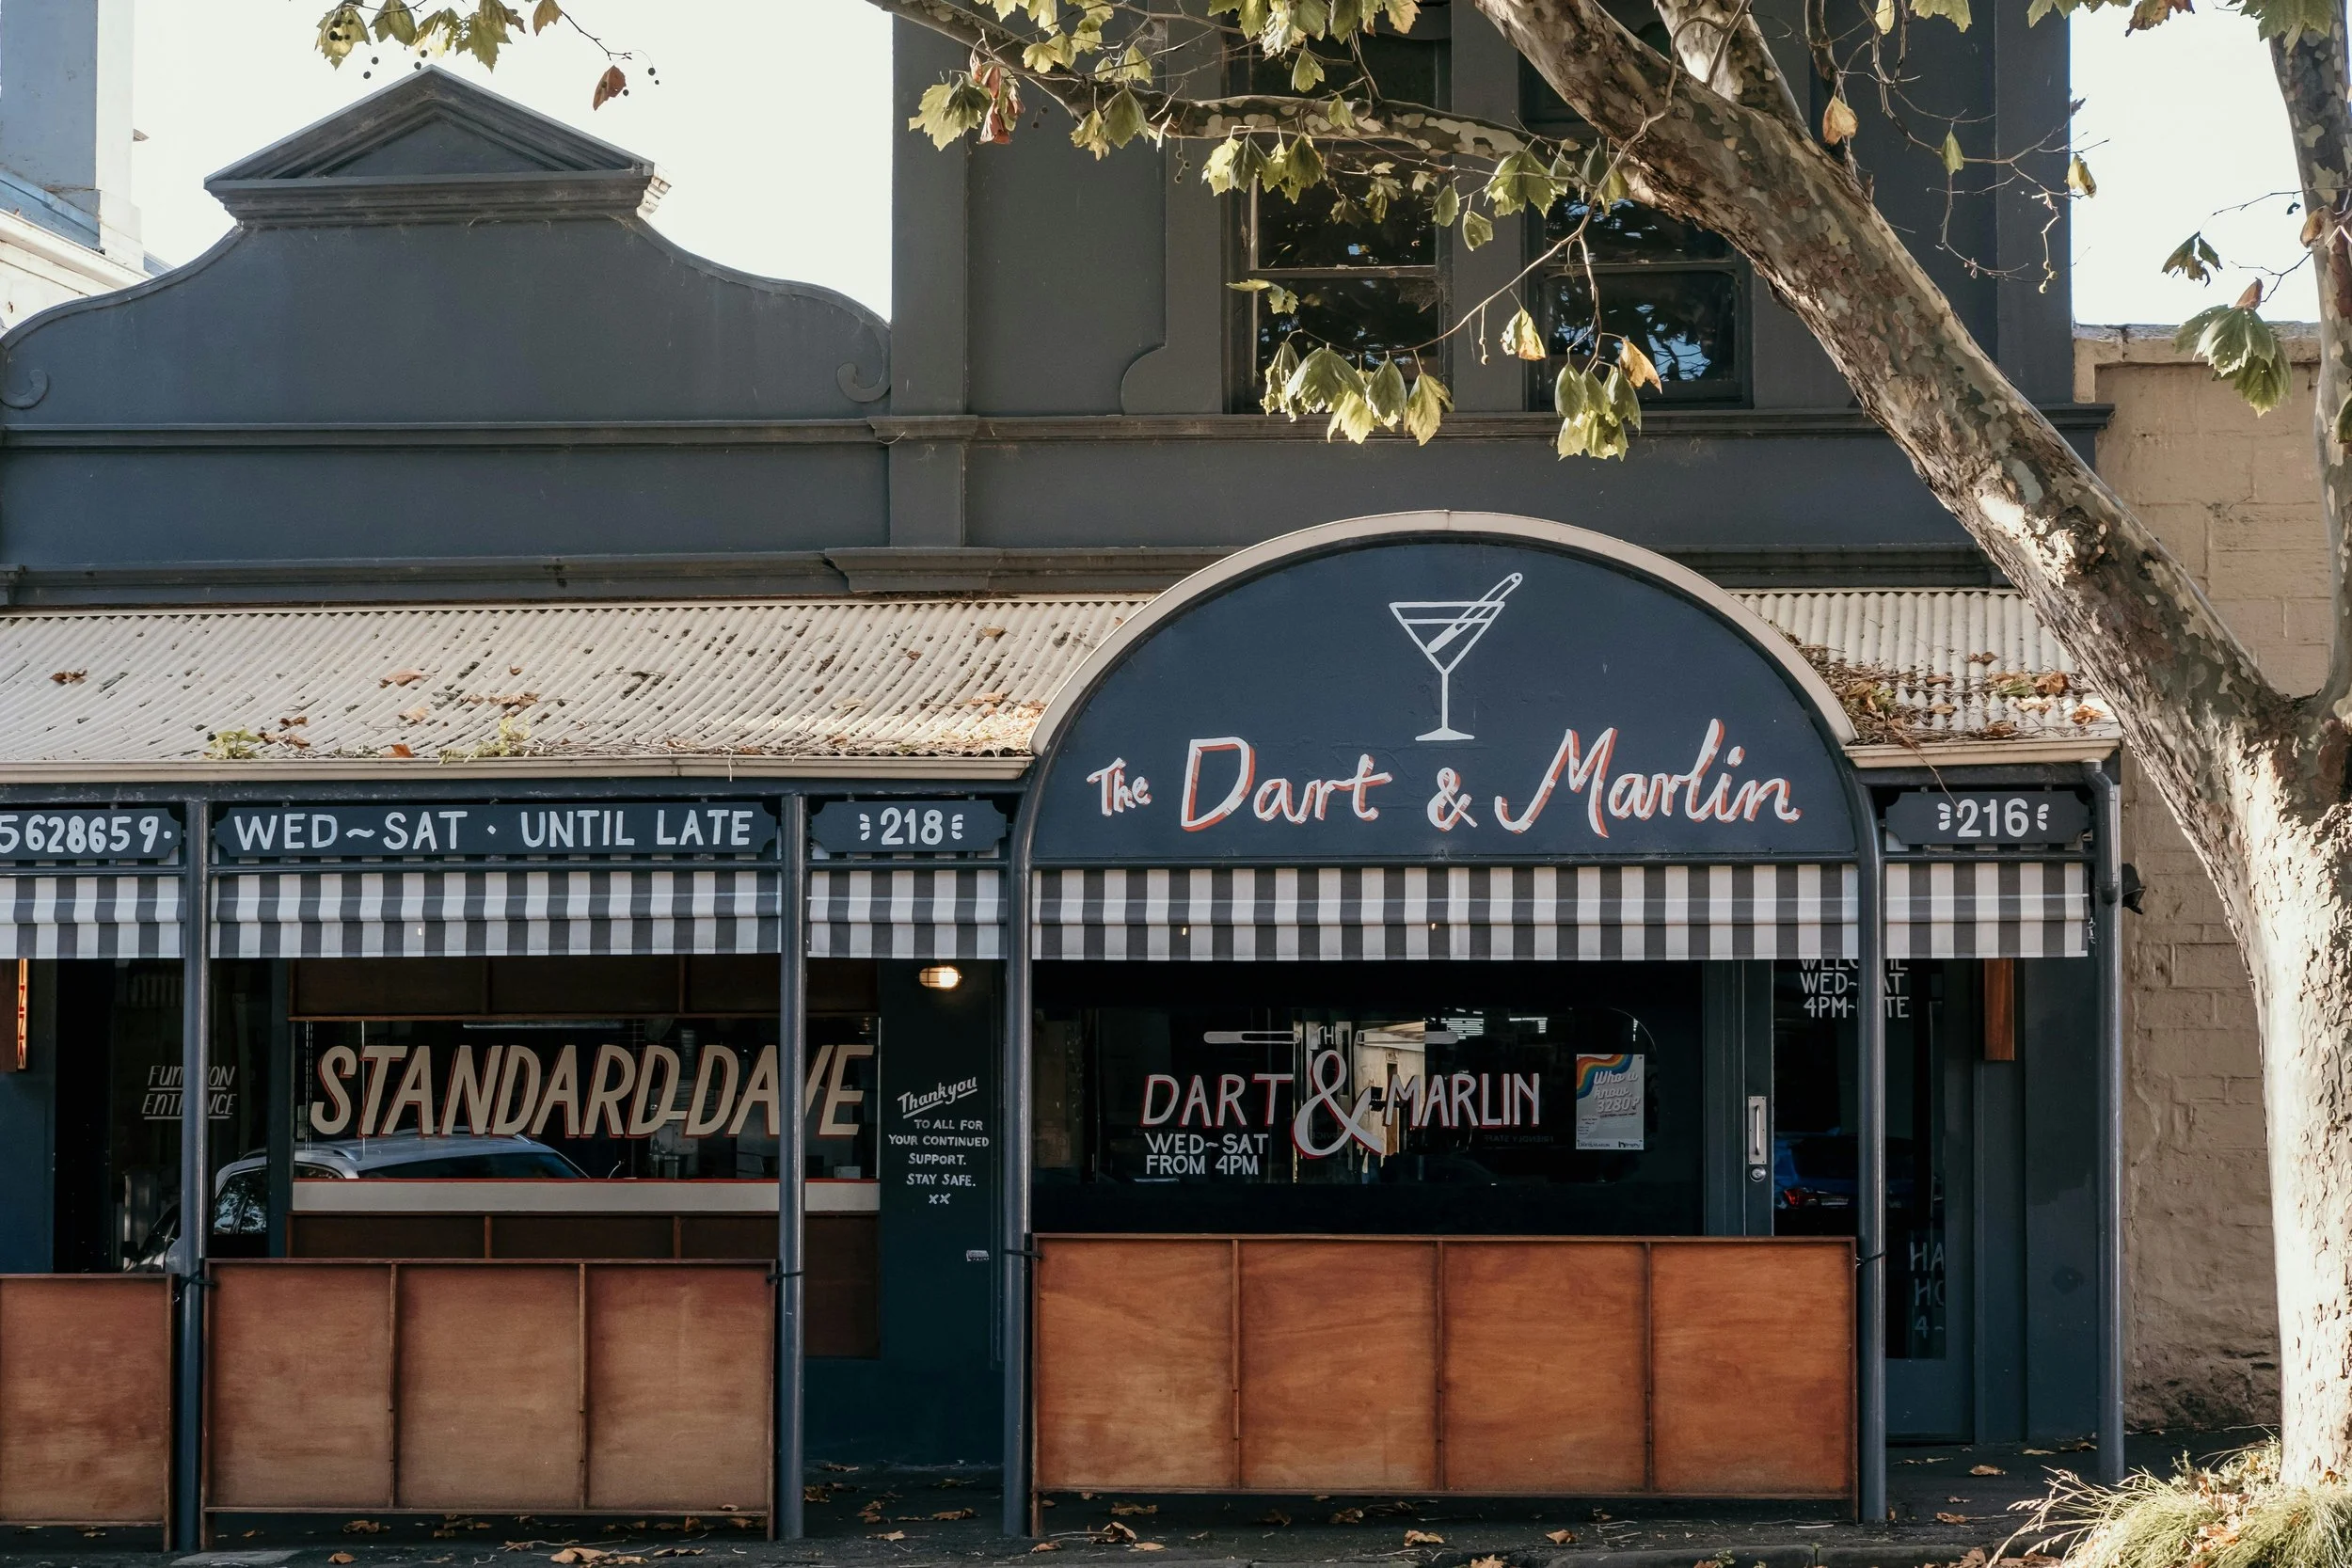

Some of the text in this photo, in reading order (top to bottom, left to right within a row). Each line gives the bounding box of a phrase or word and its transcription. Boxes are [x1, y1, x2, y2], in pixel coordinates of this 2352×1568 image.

[1087, 718, 1802, 839] The Dart & Marlin
[520, 809, 635, 848] UNTIL
[657, 809, 753, 846] LATE
[880, 807, 943, 846] 218
[1957, 798, 2028, 837] 216
[1800, 972, 1904, 994] WED~T
[1804, 996, 1910, 1018] 4PM~TE
[147, 1065, 236, 1086] FUNON
[1139, 1049, 1541, 1160] DART & MARLIN
[914, 1118, 983, 1131] TO ALL FOR
[888, 1133, 990, 1147] YOUR CONTINUED
[908, 1152, 967, 1165] SUPPORT.
[1146, 1155, 1259, 1176] FROM 4PM
[906, 1173, 977, 1187] STAY SAFE.
